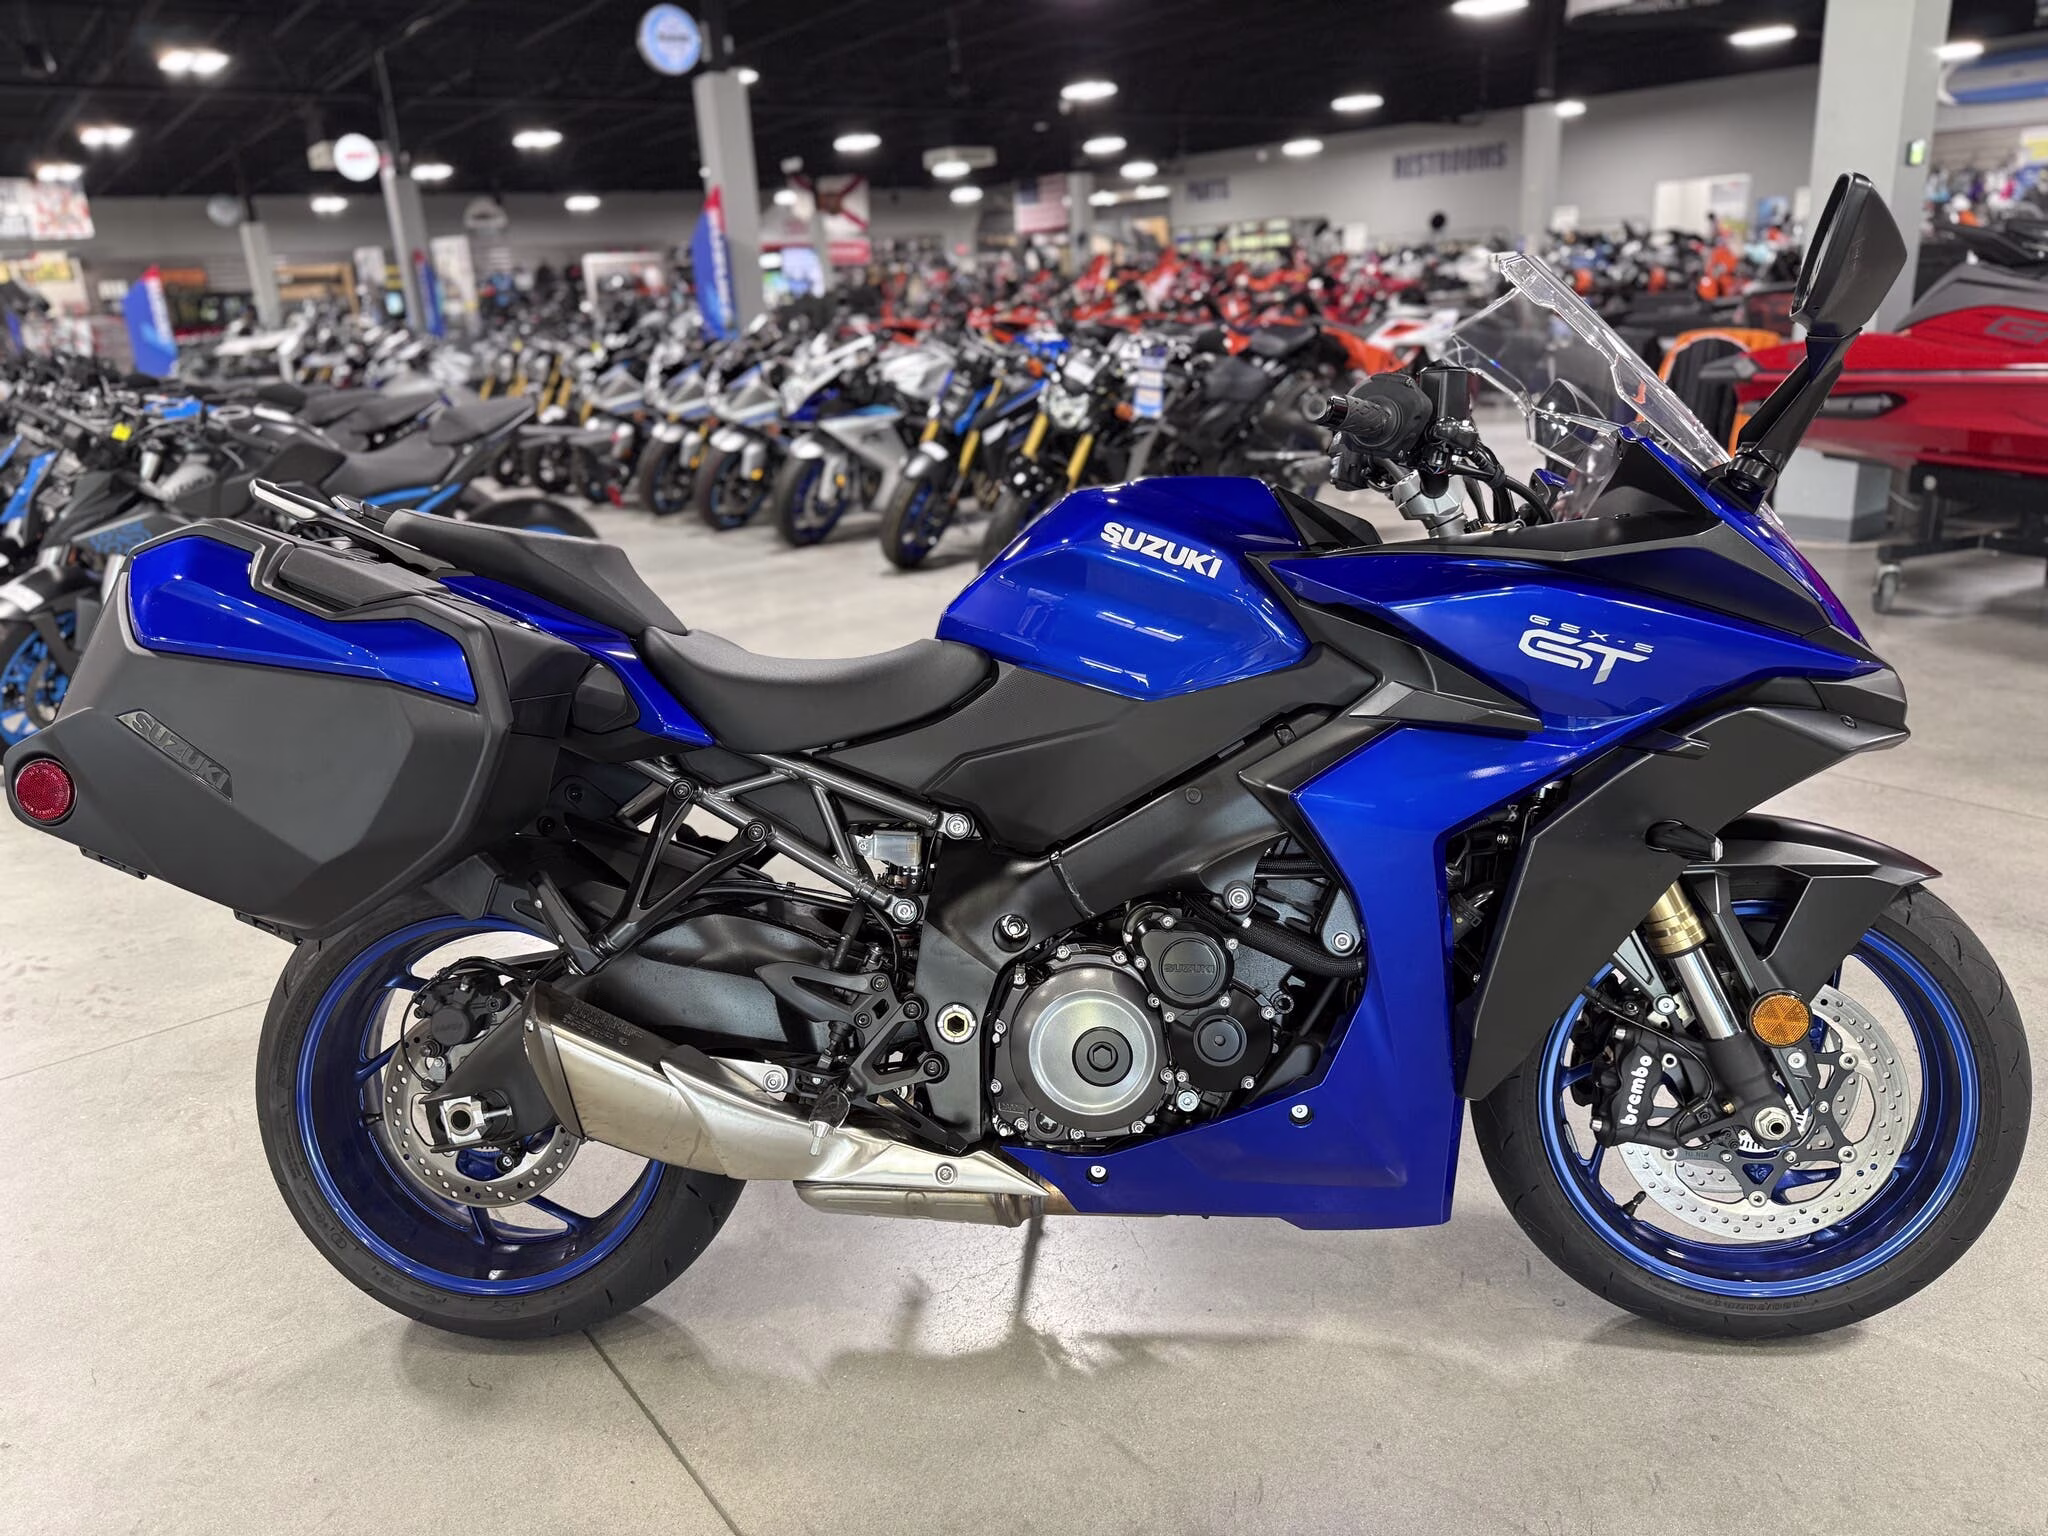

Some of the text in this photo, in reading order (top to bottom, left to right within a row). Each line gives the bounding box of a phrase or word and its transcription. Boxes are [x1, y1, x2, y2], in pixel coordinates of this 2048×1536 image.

[1100, 521, 1223, 578] SUZUKI
[1518, 628, 1650, 685] GT
[132, 712, 229, 791] SUZUKI
[1163, 962, 1216, 974] SUZUKI
[1620, 1055, 1653, 1126] brembo
